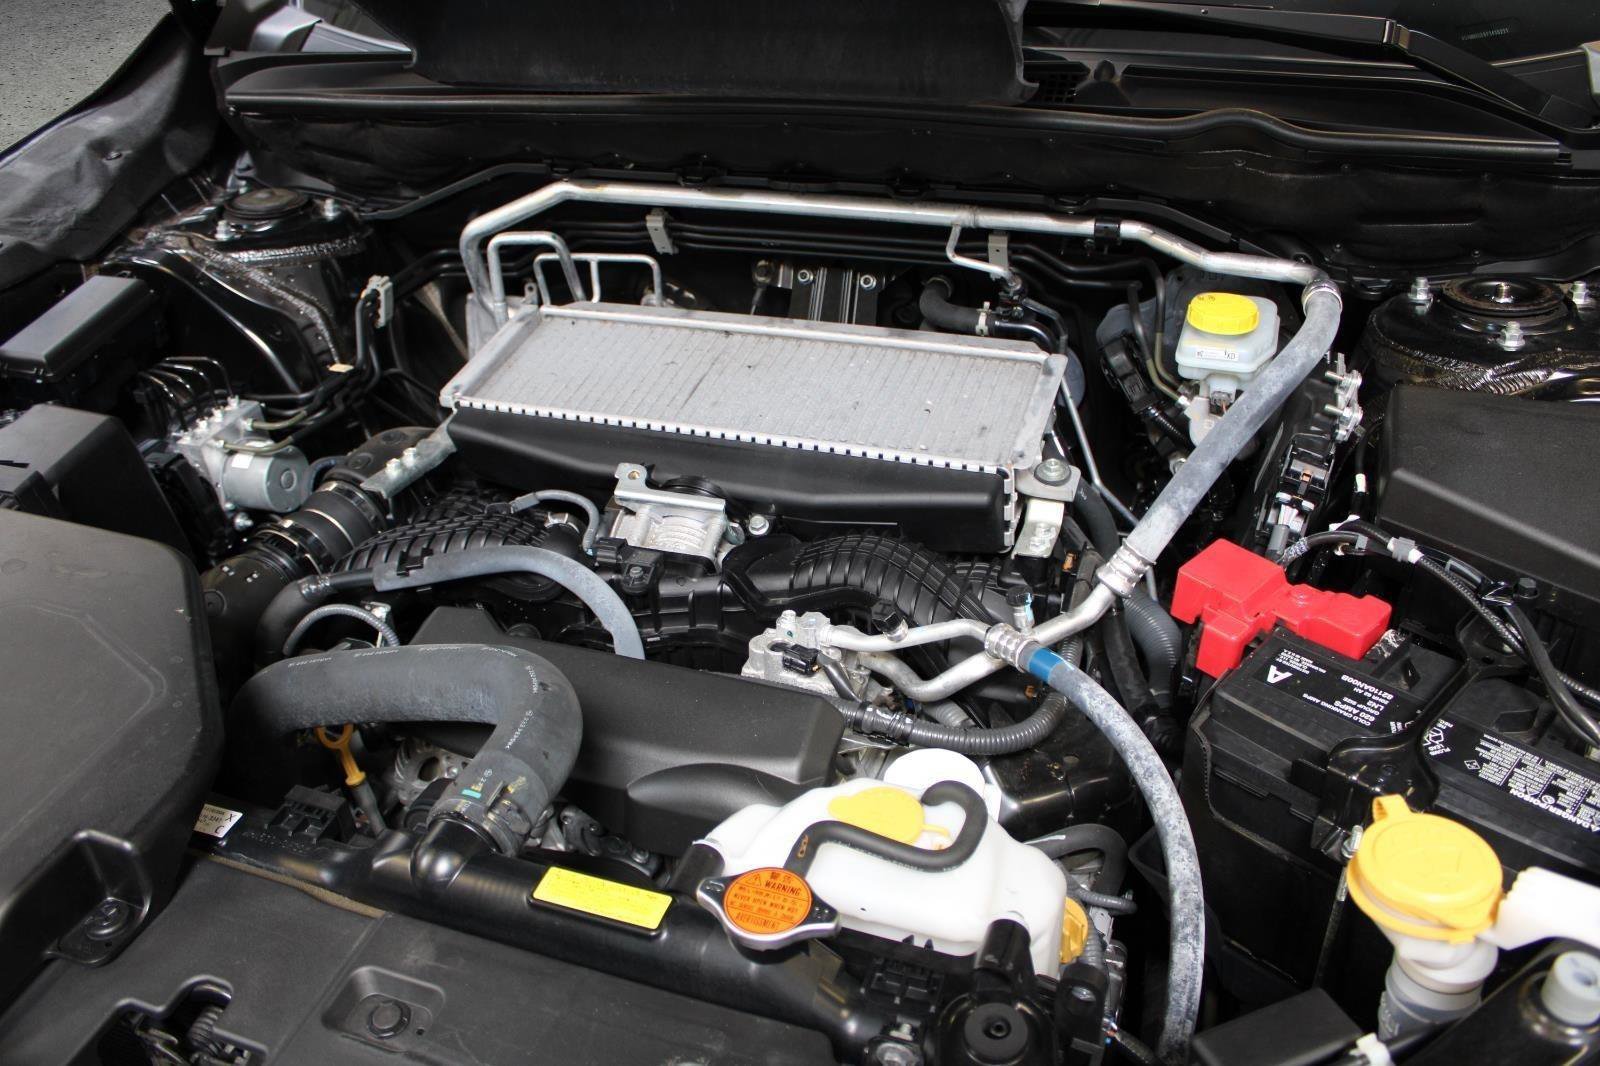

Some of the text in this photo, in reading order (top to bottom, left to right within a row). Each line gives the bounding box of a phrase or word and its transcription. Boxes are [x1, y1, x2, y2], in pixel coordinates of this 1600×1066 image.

[1267, 665, 1292, 683] A
[1301, 693, 1371, 726] COLD CRANKING AMPS
[1332, 700, 1376, 721] 620 AMPS
[1342, 696, 1380, 715] GROUP SIZE
[1365, 700, 1385, 710] LN2
[765, 880, 802, 896] WARNING
